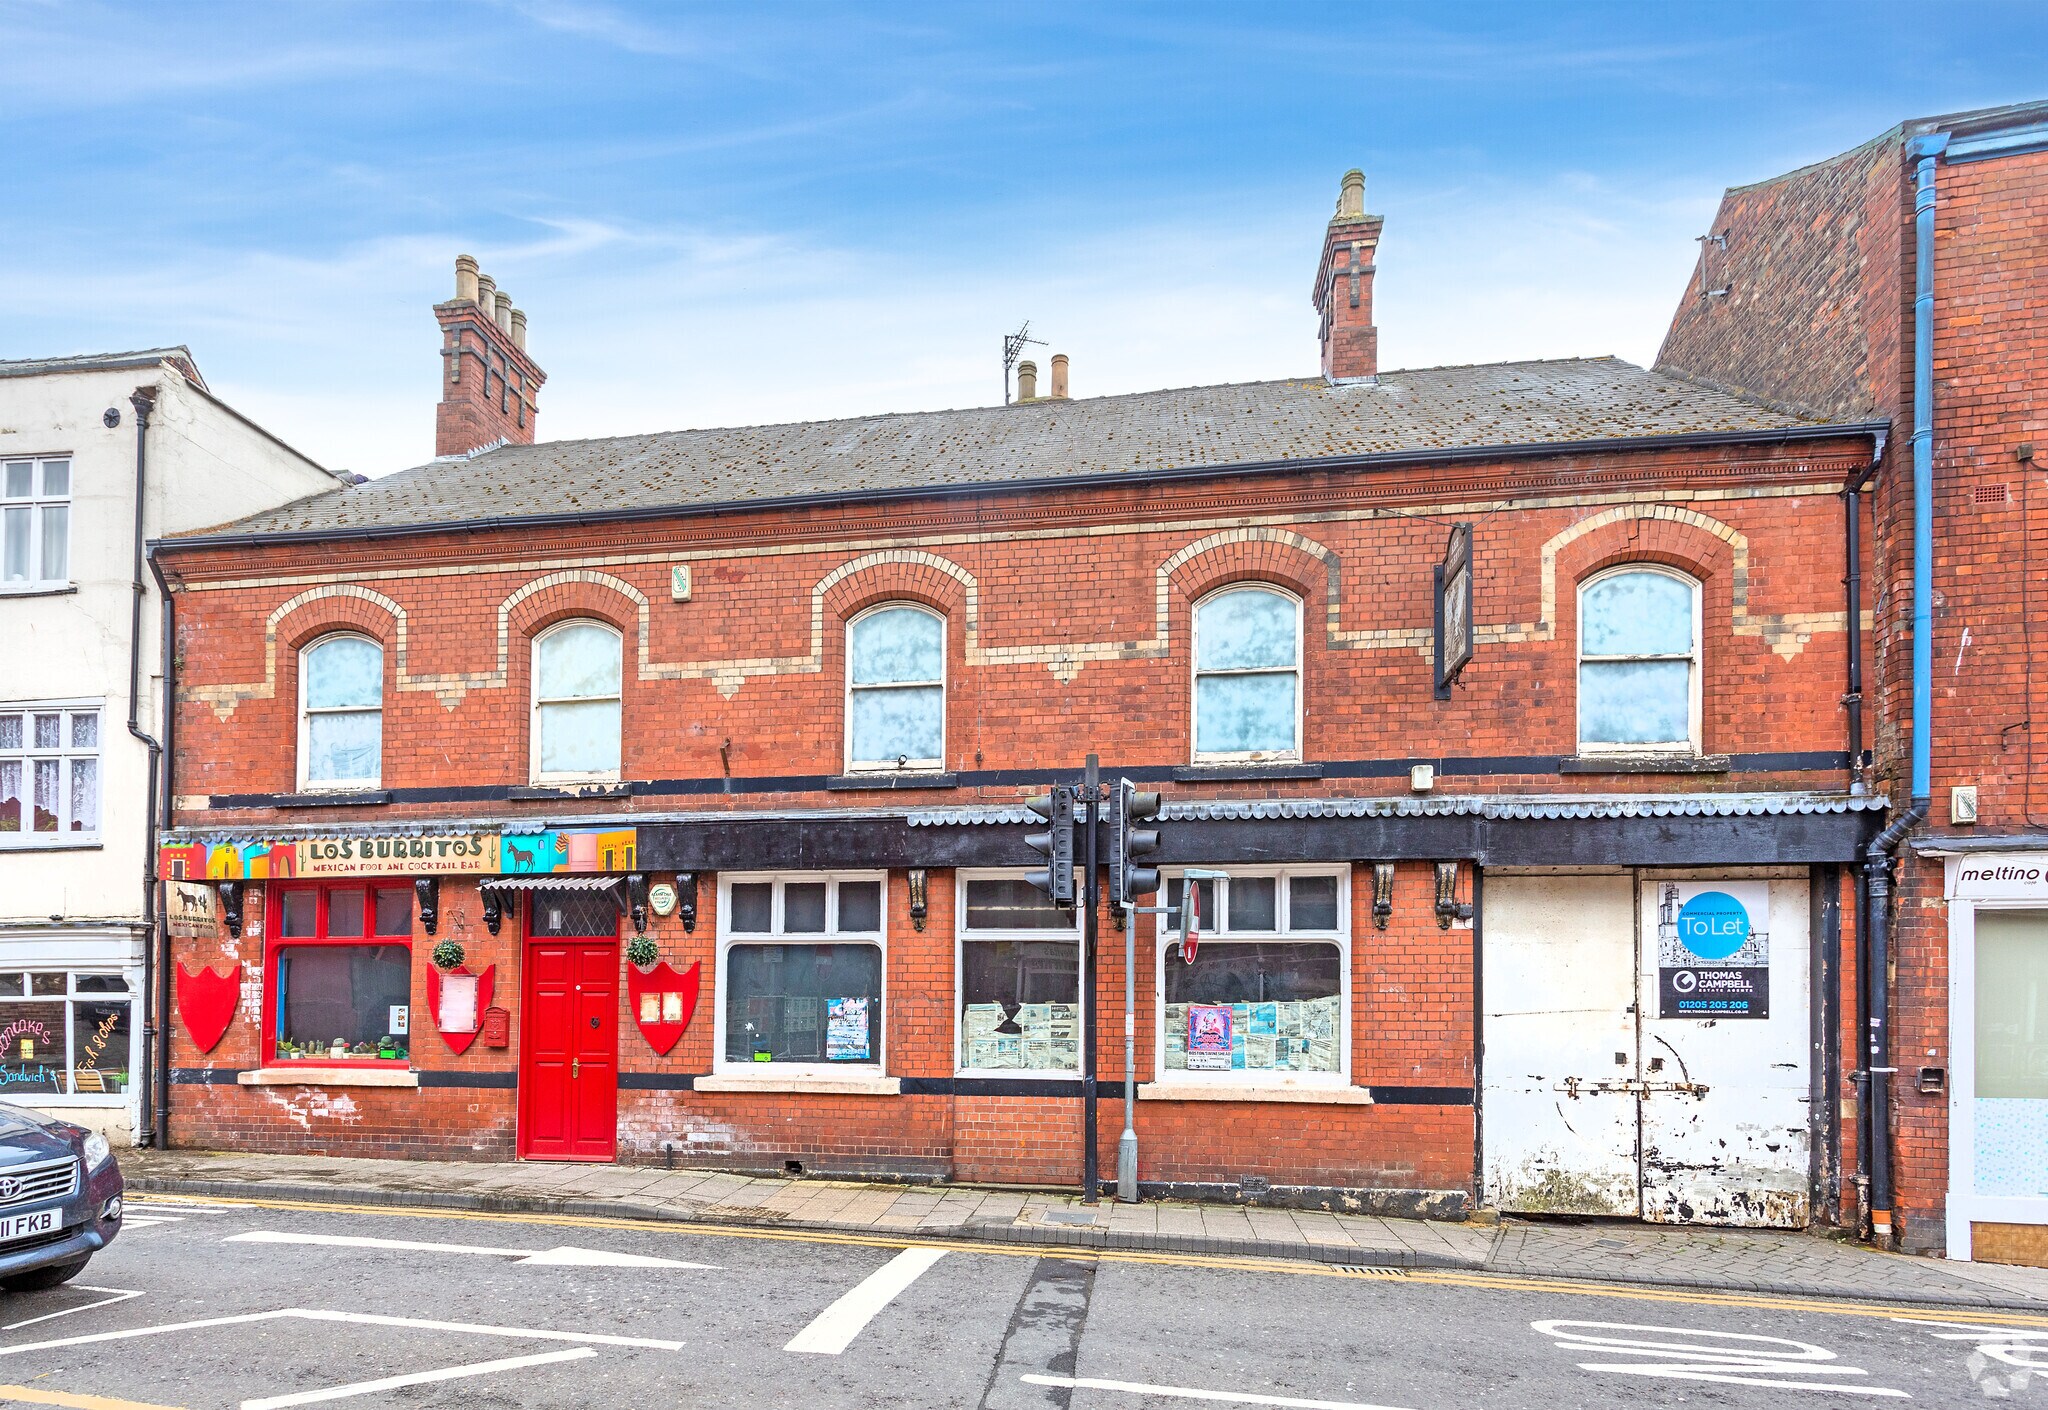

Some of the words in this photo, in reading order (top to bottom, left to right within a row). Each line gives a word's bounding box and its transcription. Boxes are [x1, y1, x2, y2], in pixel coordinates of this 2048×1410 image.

[310, 839, 353, 859] LOS
[359, 836, 483, 858] BURRITOS
[313, 863, 356, 872] MEXICAN
[360, 862, 384, 871] FOOD
[387, 862, 404, 871] AND
[408, 861, 458, 870] COCKTAIL
[461, 859, 481, 869] BAR
[1961, 866, 2040, 881] meltino
[1681, 917, 1708, 936] To
[1711, 917, 1744, 936] Let
[1698, 971, 1742, 980] THOMAS
[1698, 980, 1753, 988] CAMPBELL
[1679, 1000, 1707, 1009] 01205
[1709, 1001, 1727, 1009] 205
[1729, 1001, 1749, 1009] 206
[77, 1045, 99, 1077] Fish
[16, 1213, 52, 1235] FKB
